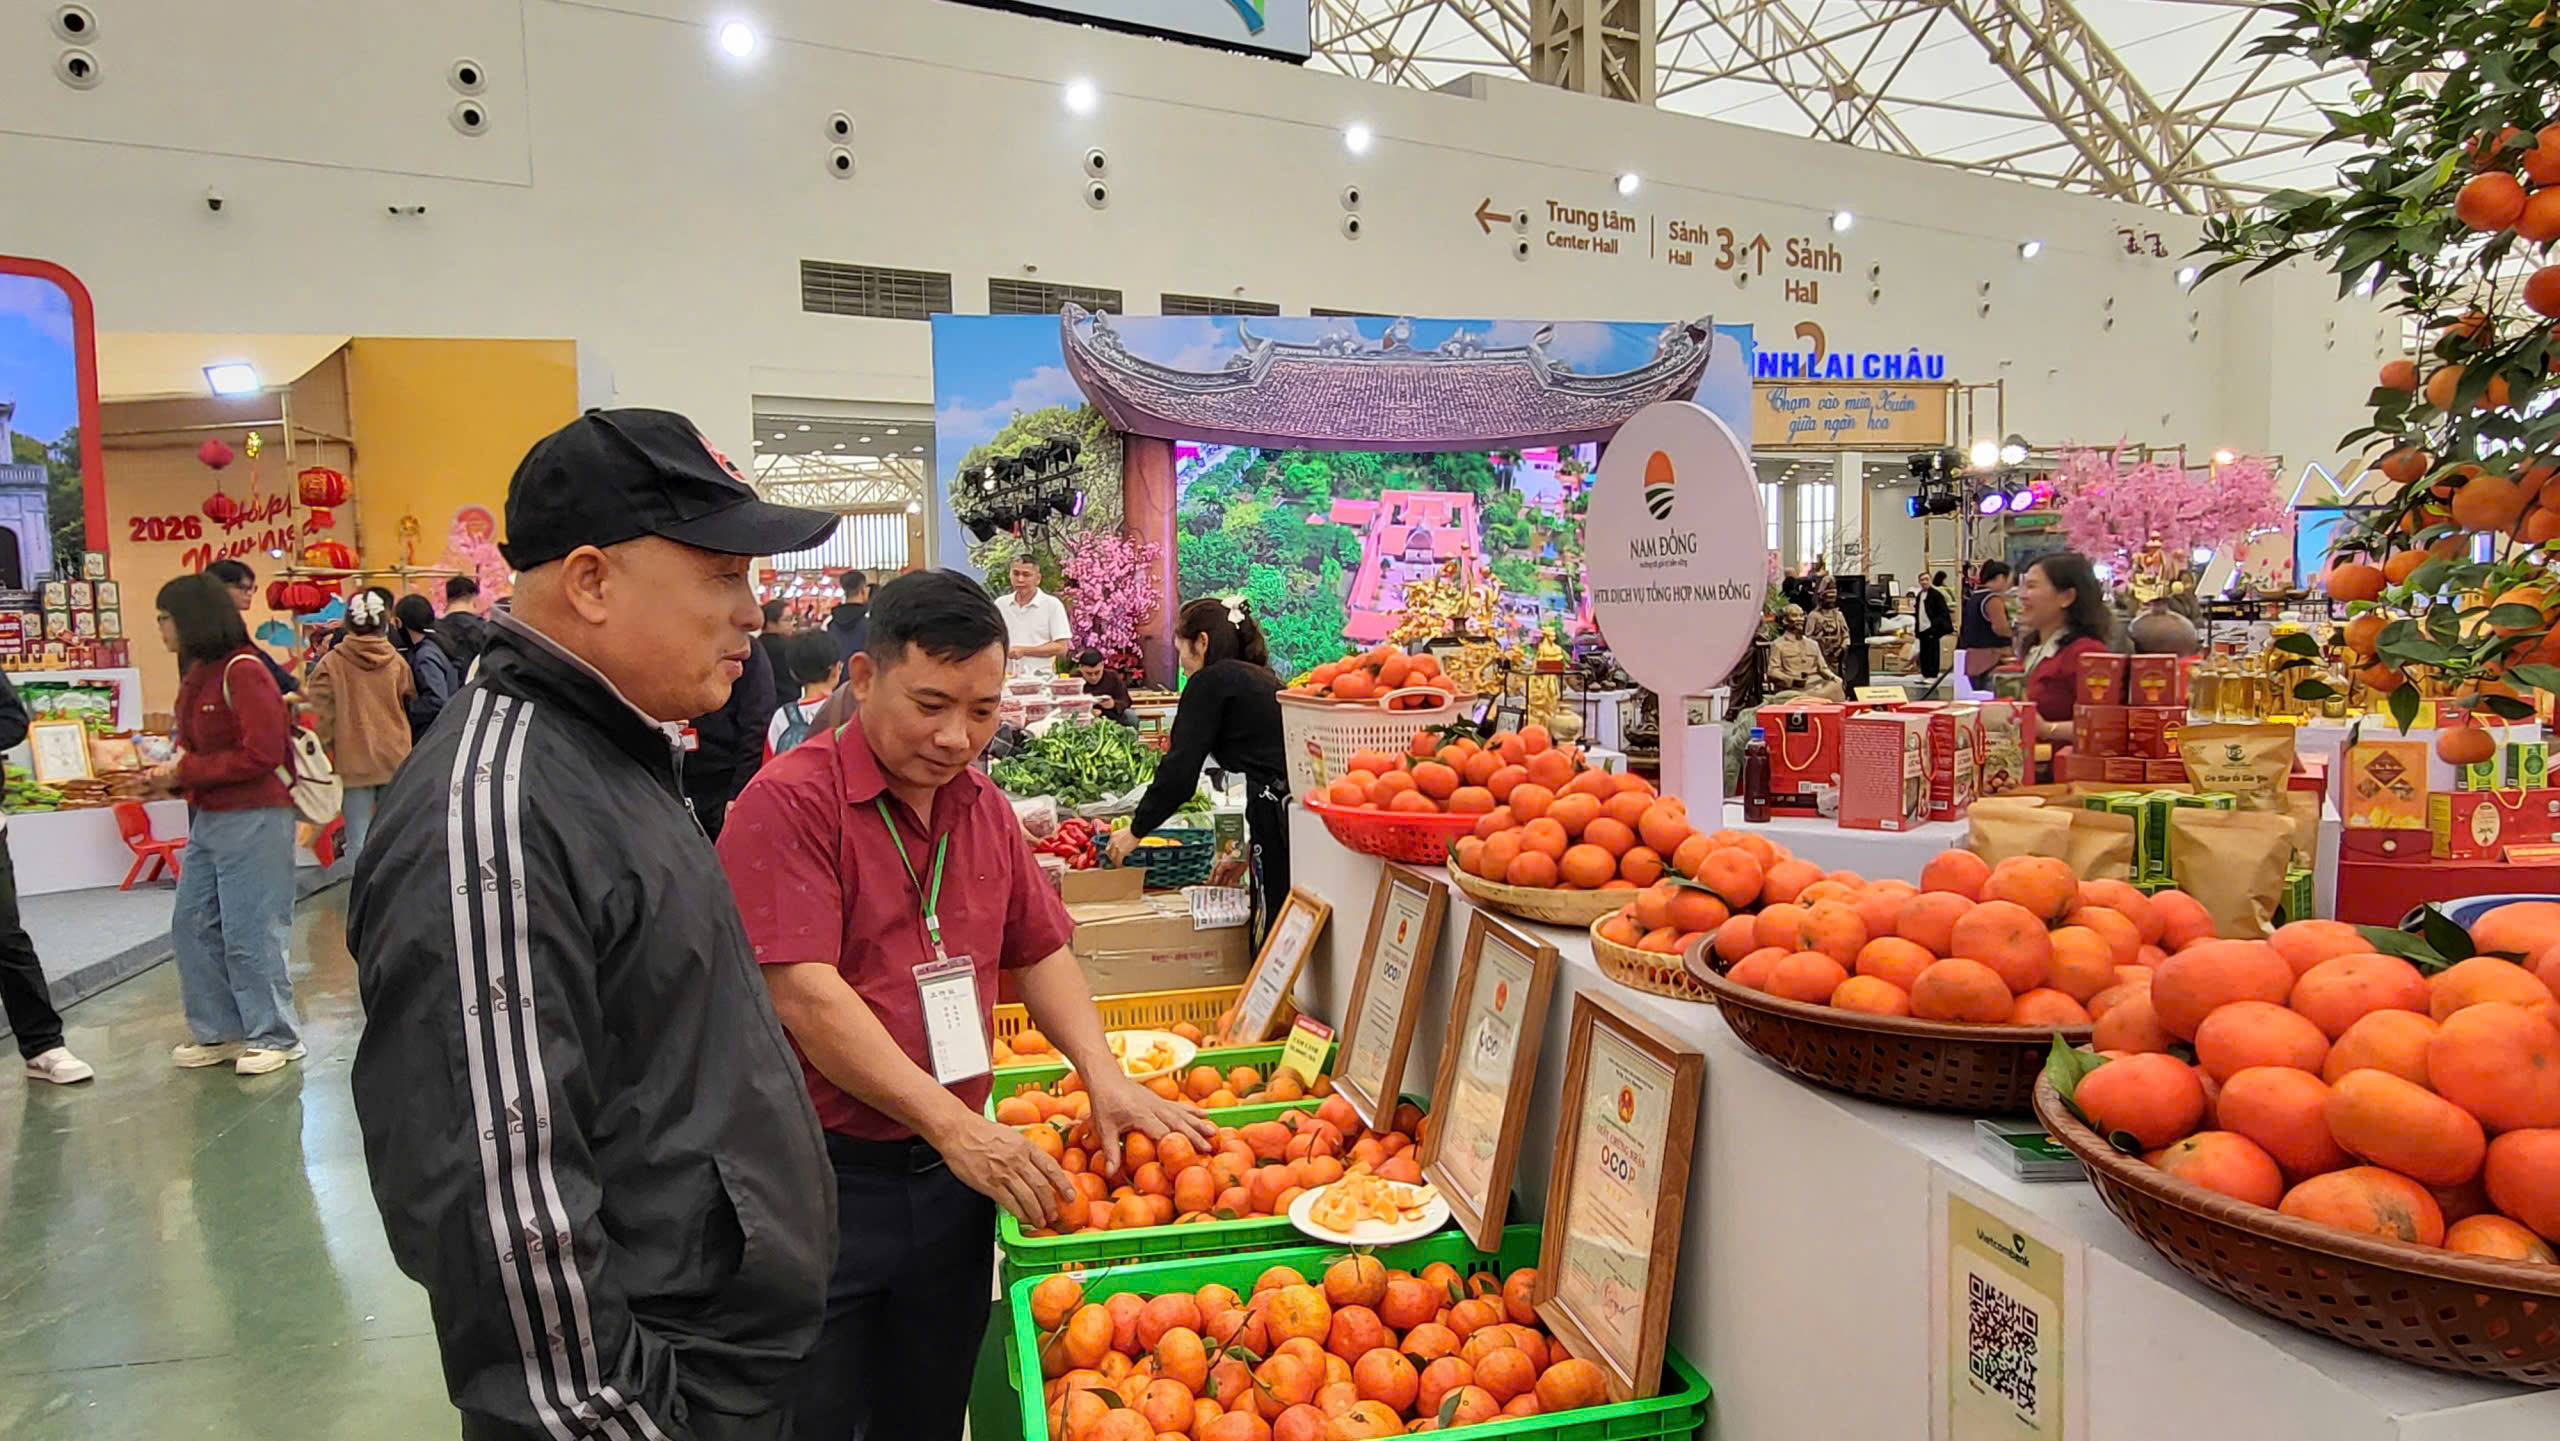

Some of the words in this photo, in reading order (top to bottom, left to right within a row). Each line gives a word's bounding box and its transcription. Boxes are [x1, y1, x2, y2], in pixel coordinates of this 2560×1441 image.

[1546, 200, 1600, 232] Trung
[1603, 210, 1636, 233] tâm
[1546, 230, 1590, 251] Center
[1593, 237, 1619, 255] Hall
[1668, 221, 1709, 245] Sảnh
[1714, 226, 1735, 271] 3
[1669, 249, 1693, 266] Hall
[1785, 237, 1842, 273] Sảnh
[1785, 278, 1818, 305] Hall
[1807, 353, 1854, 379] LAI
[1862, 347, 1945, 380] CHÂU
[1767, 387, 1811, 414] Chạm
[1845, 391, 1872, 410] mùa
[1875, 390, 1918, 412] Xuân
[1787, 415, 1817, 442] giữa
[1823, 414, 1856, 440] ngàn
[1867, 408, 1890, 430] hoa
[129, 515, 203, 542] 2026
[1630, 537, 1657, 560] NAM
[1659, 527, 1698, 557] ĐỒNG
[1610, 587, 1632, 605] DỊCH
[1673, 585, 1692, 605] HỢP
[1693, 585, 1716, 601] NAM
[1601, 1144, 1637, 1184] OCOP
[1976, 1227, 2031, 1269] Vietcombank
